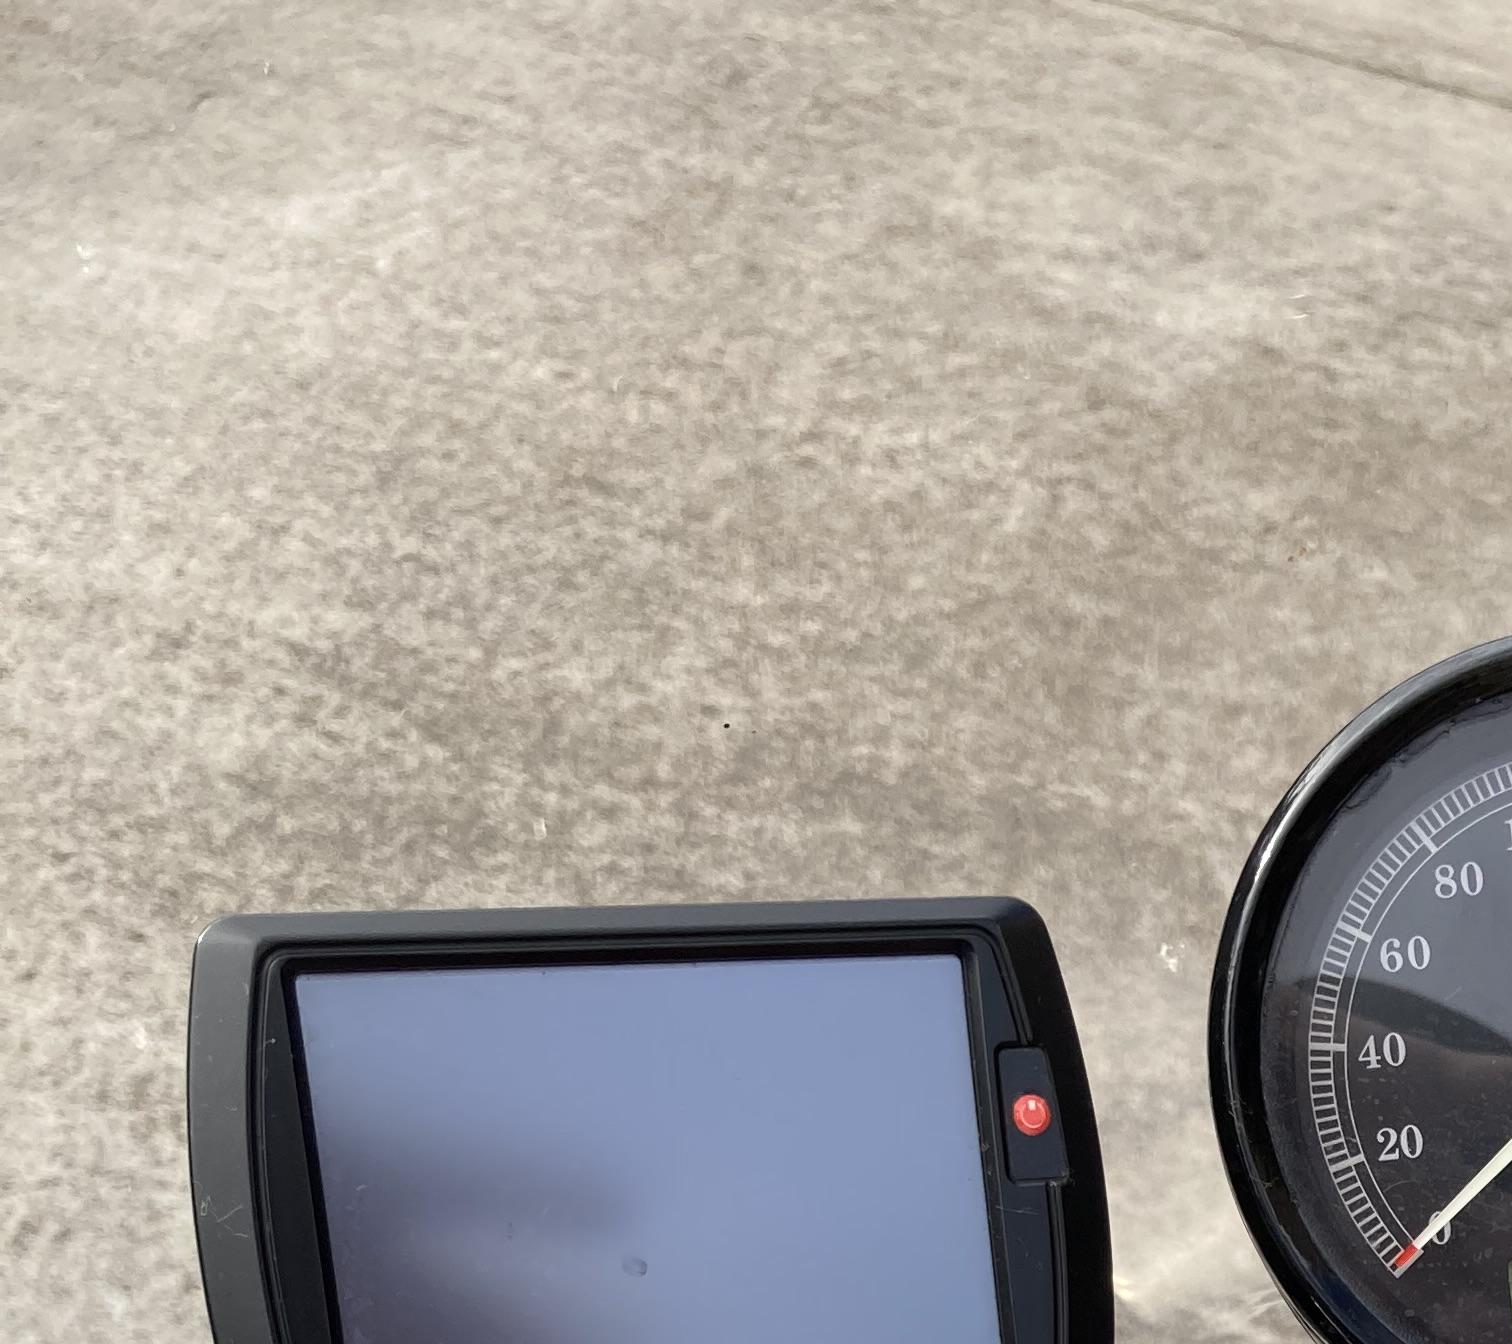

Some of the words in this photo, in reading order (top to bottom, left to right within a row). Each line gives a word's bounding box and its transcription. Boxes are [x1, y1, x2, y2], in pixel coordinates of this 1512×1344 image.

[1434, 861, 1484, 899] 80
[1380, 935, 1431, 973] 60
[1358, 1032, 1406, 1069] 40
[1376, 1124, 1424, 1162] 20
